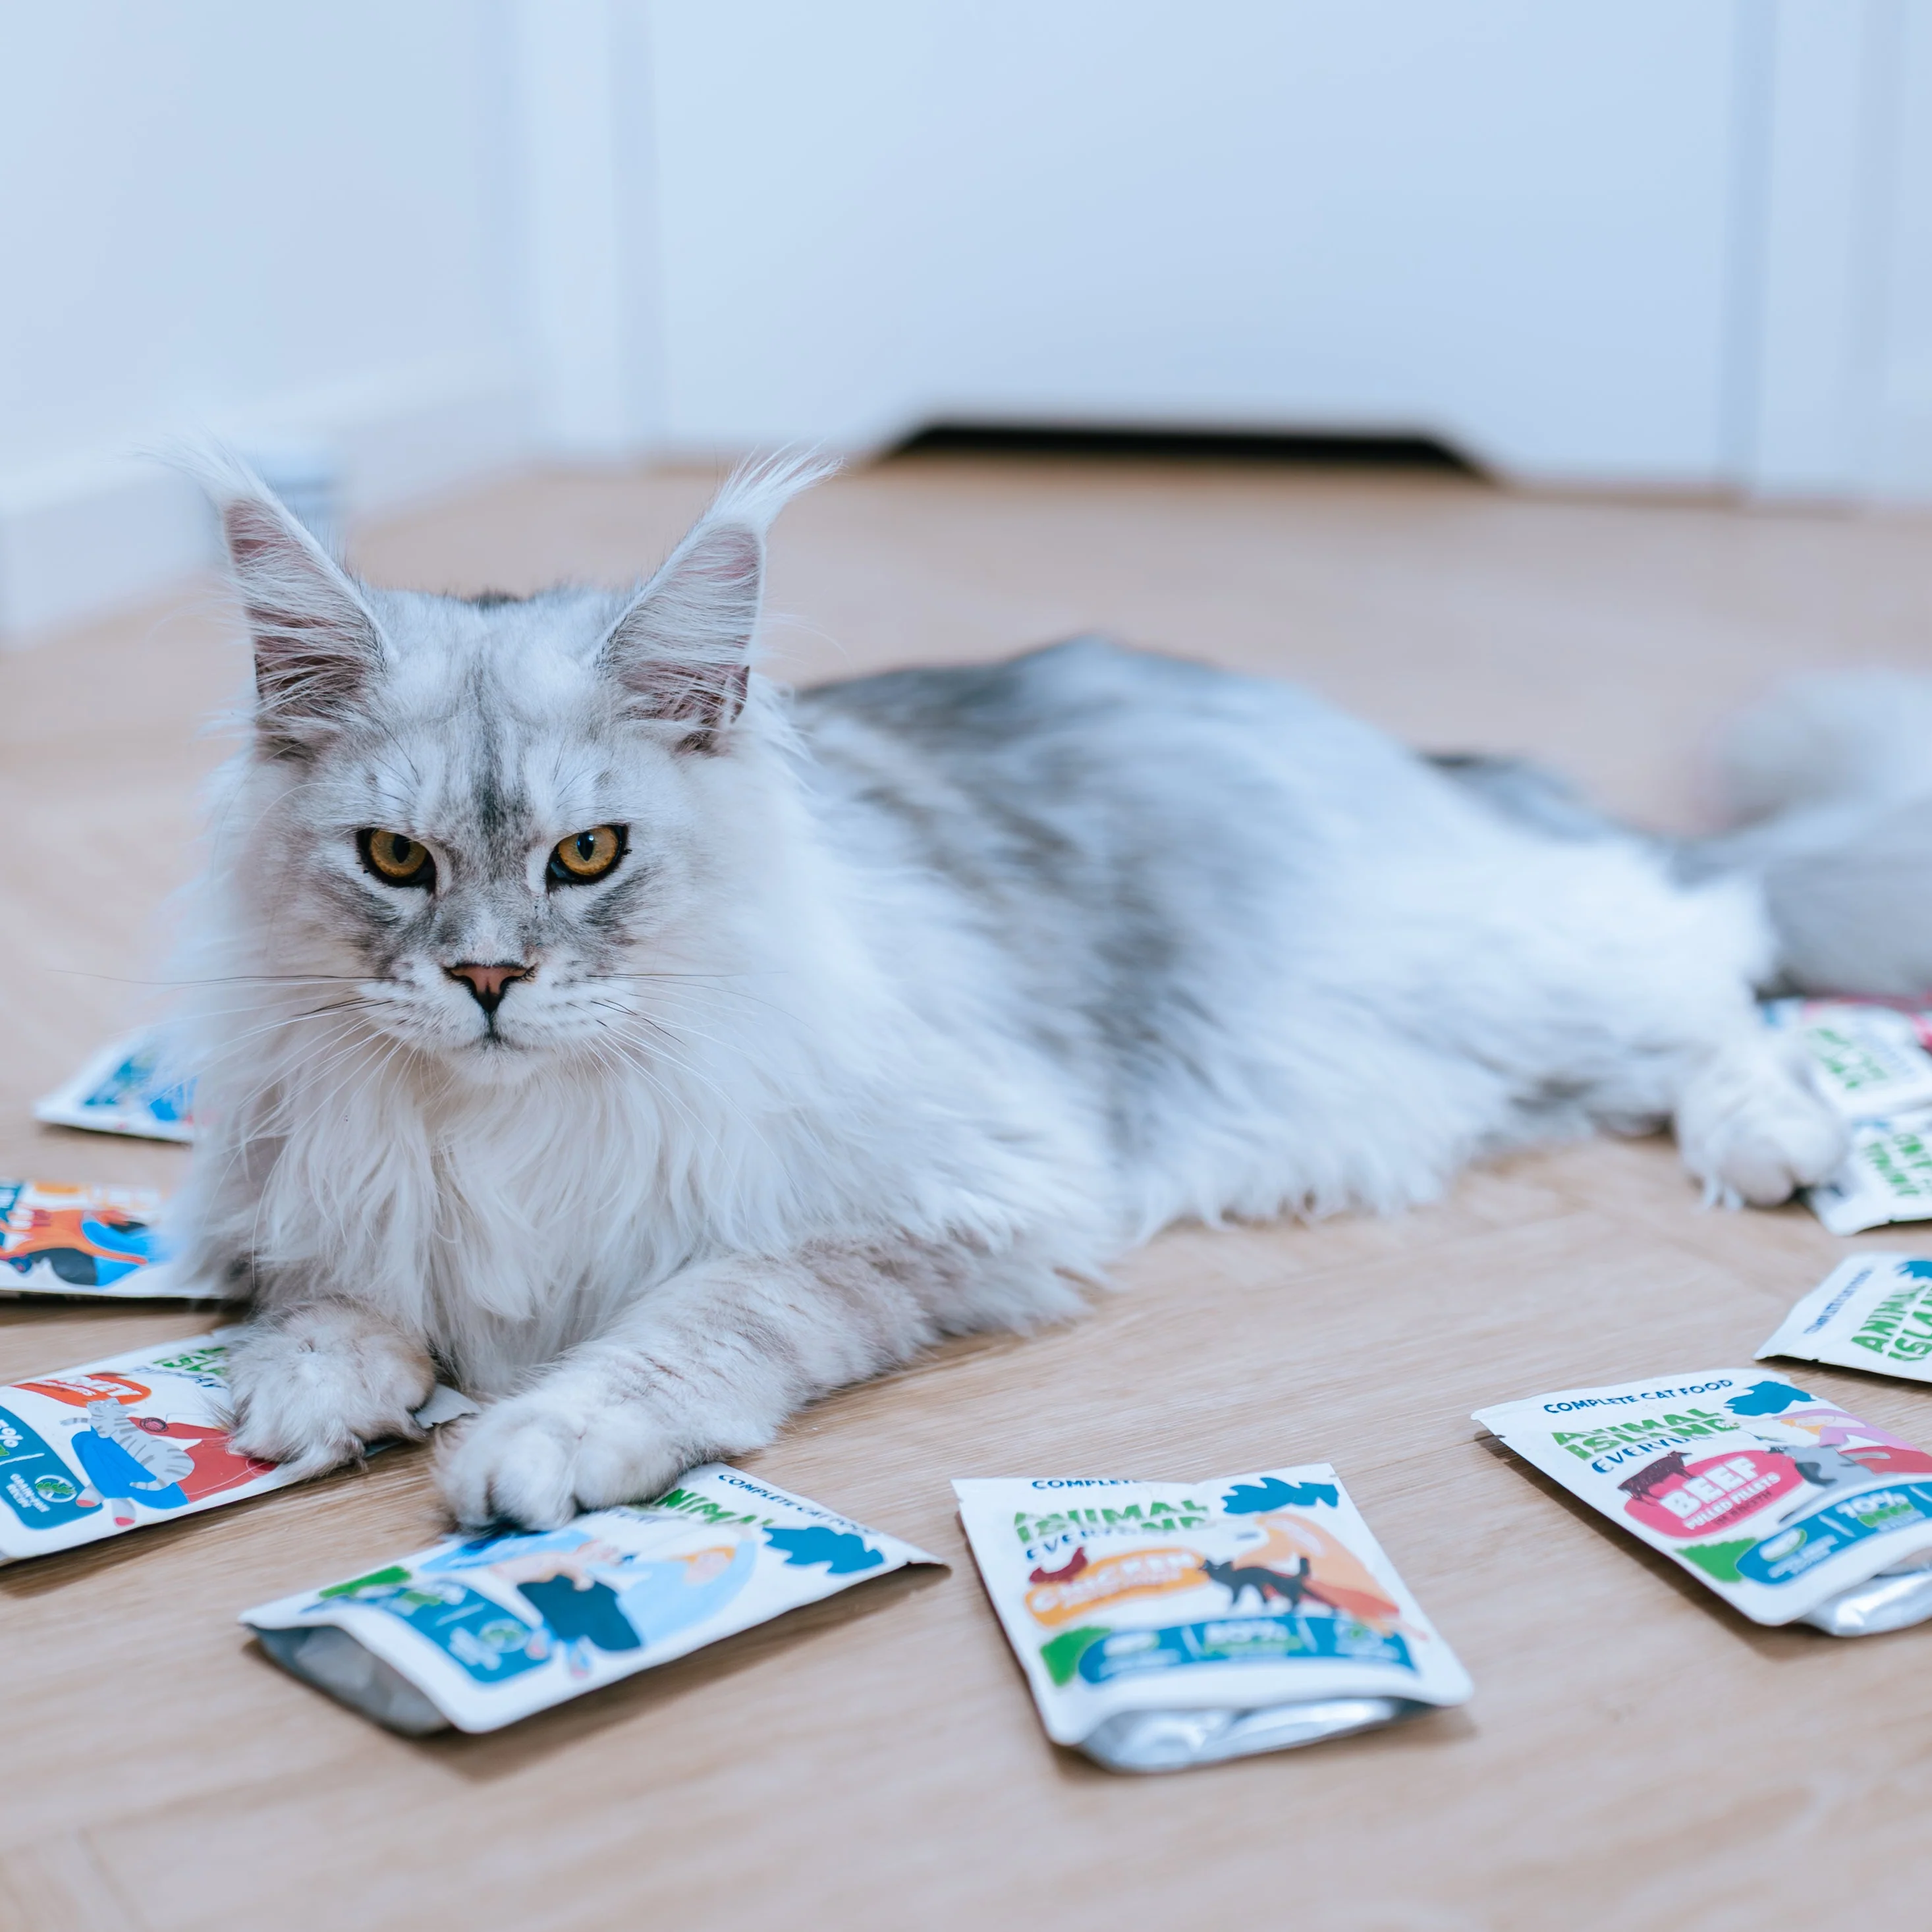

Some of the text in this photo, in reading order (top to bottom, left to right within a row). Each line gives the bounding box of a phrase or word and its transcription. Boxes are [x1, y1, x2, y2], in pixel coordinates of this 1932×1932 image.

[1543, 1379, 1734, 1414] COMPLETE CAT FOOD
[1657, 1456, 1758, 1519] BEEF
[1683, 1499, 1734, 1530] PULLED
